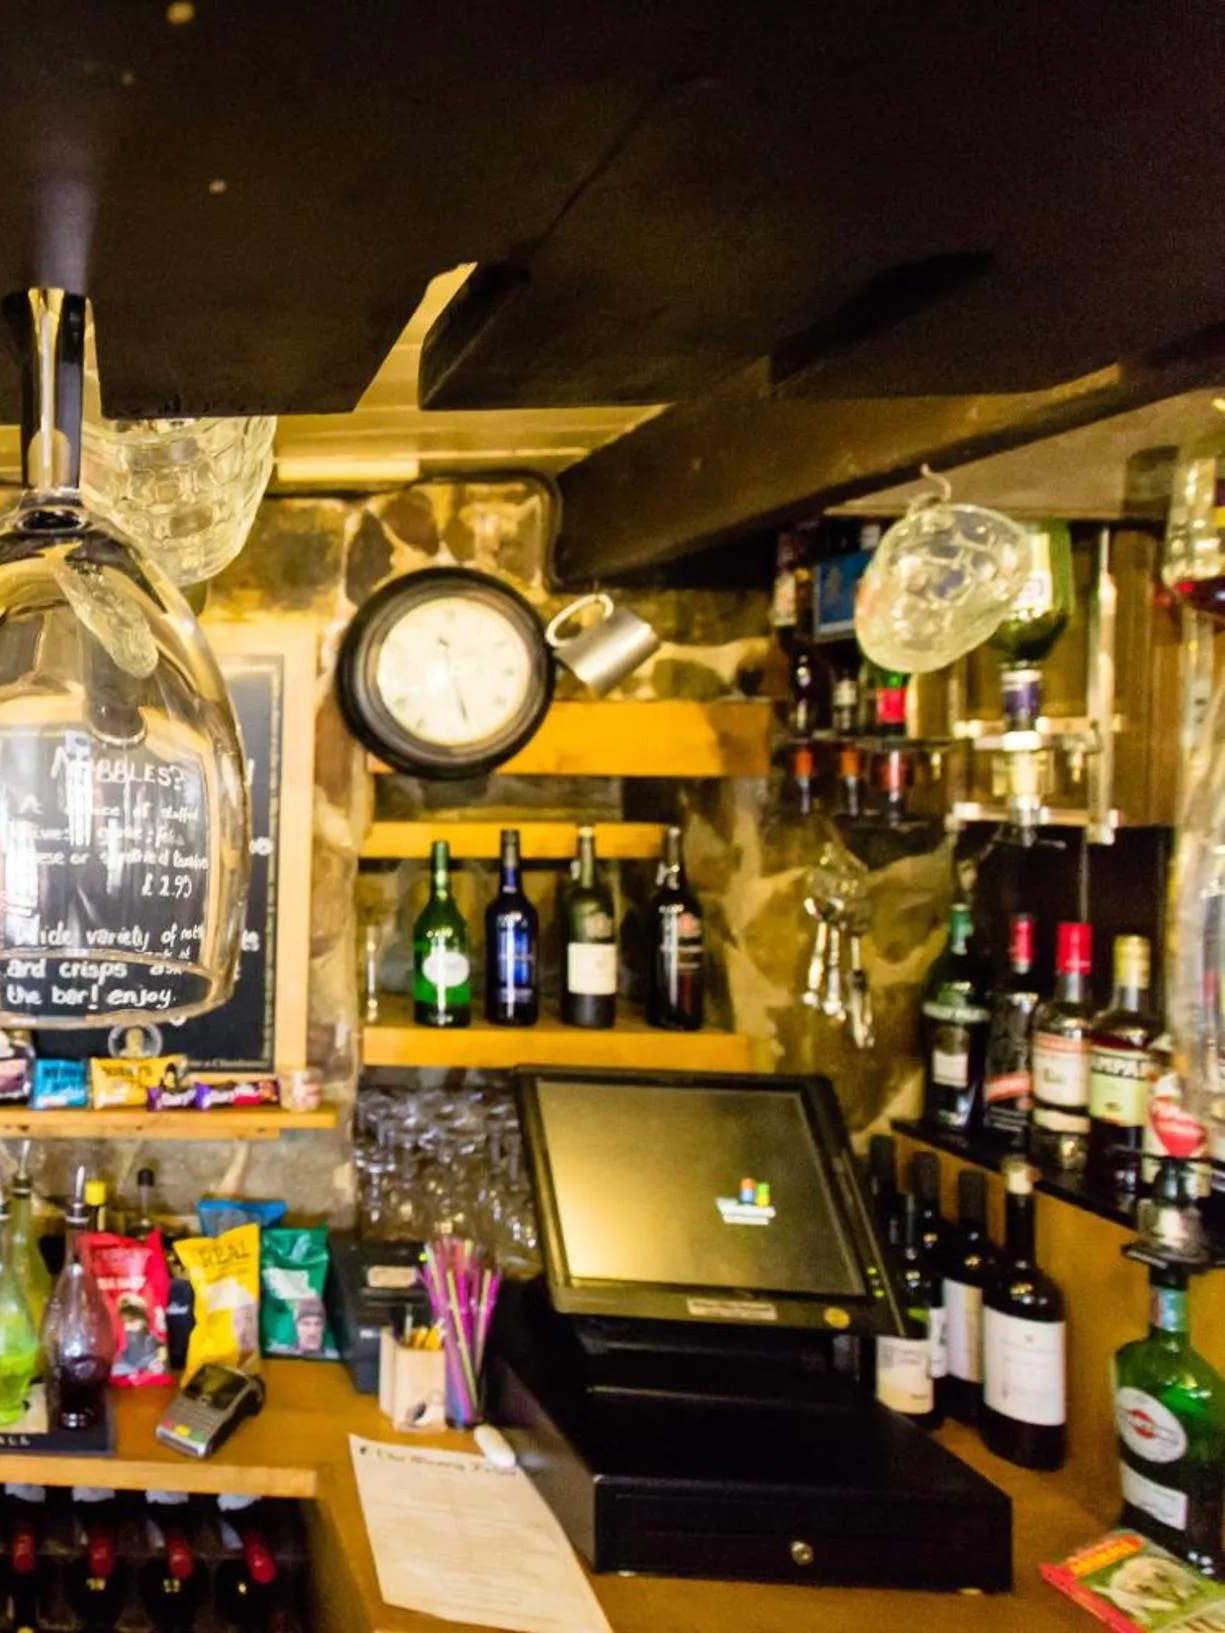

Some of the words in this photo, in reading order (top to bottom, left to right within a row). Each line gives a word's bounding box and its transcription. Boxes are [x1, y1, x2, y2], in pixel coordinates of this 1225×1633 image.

[84, 923, 150, 953] variety
[160, 922, 178, 945] of
[58, 959, 128, 986] crisps
[6, 984, 42, 1005] the
[198, 1239, 252, 1267] REAL
